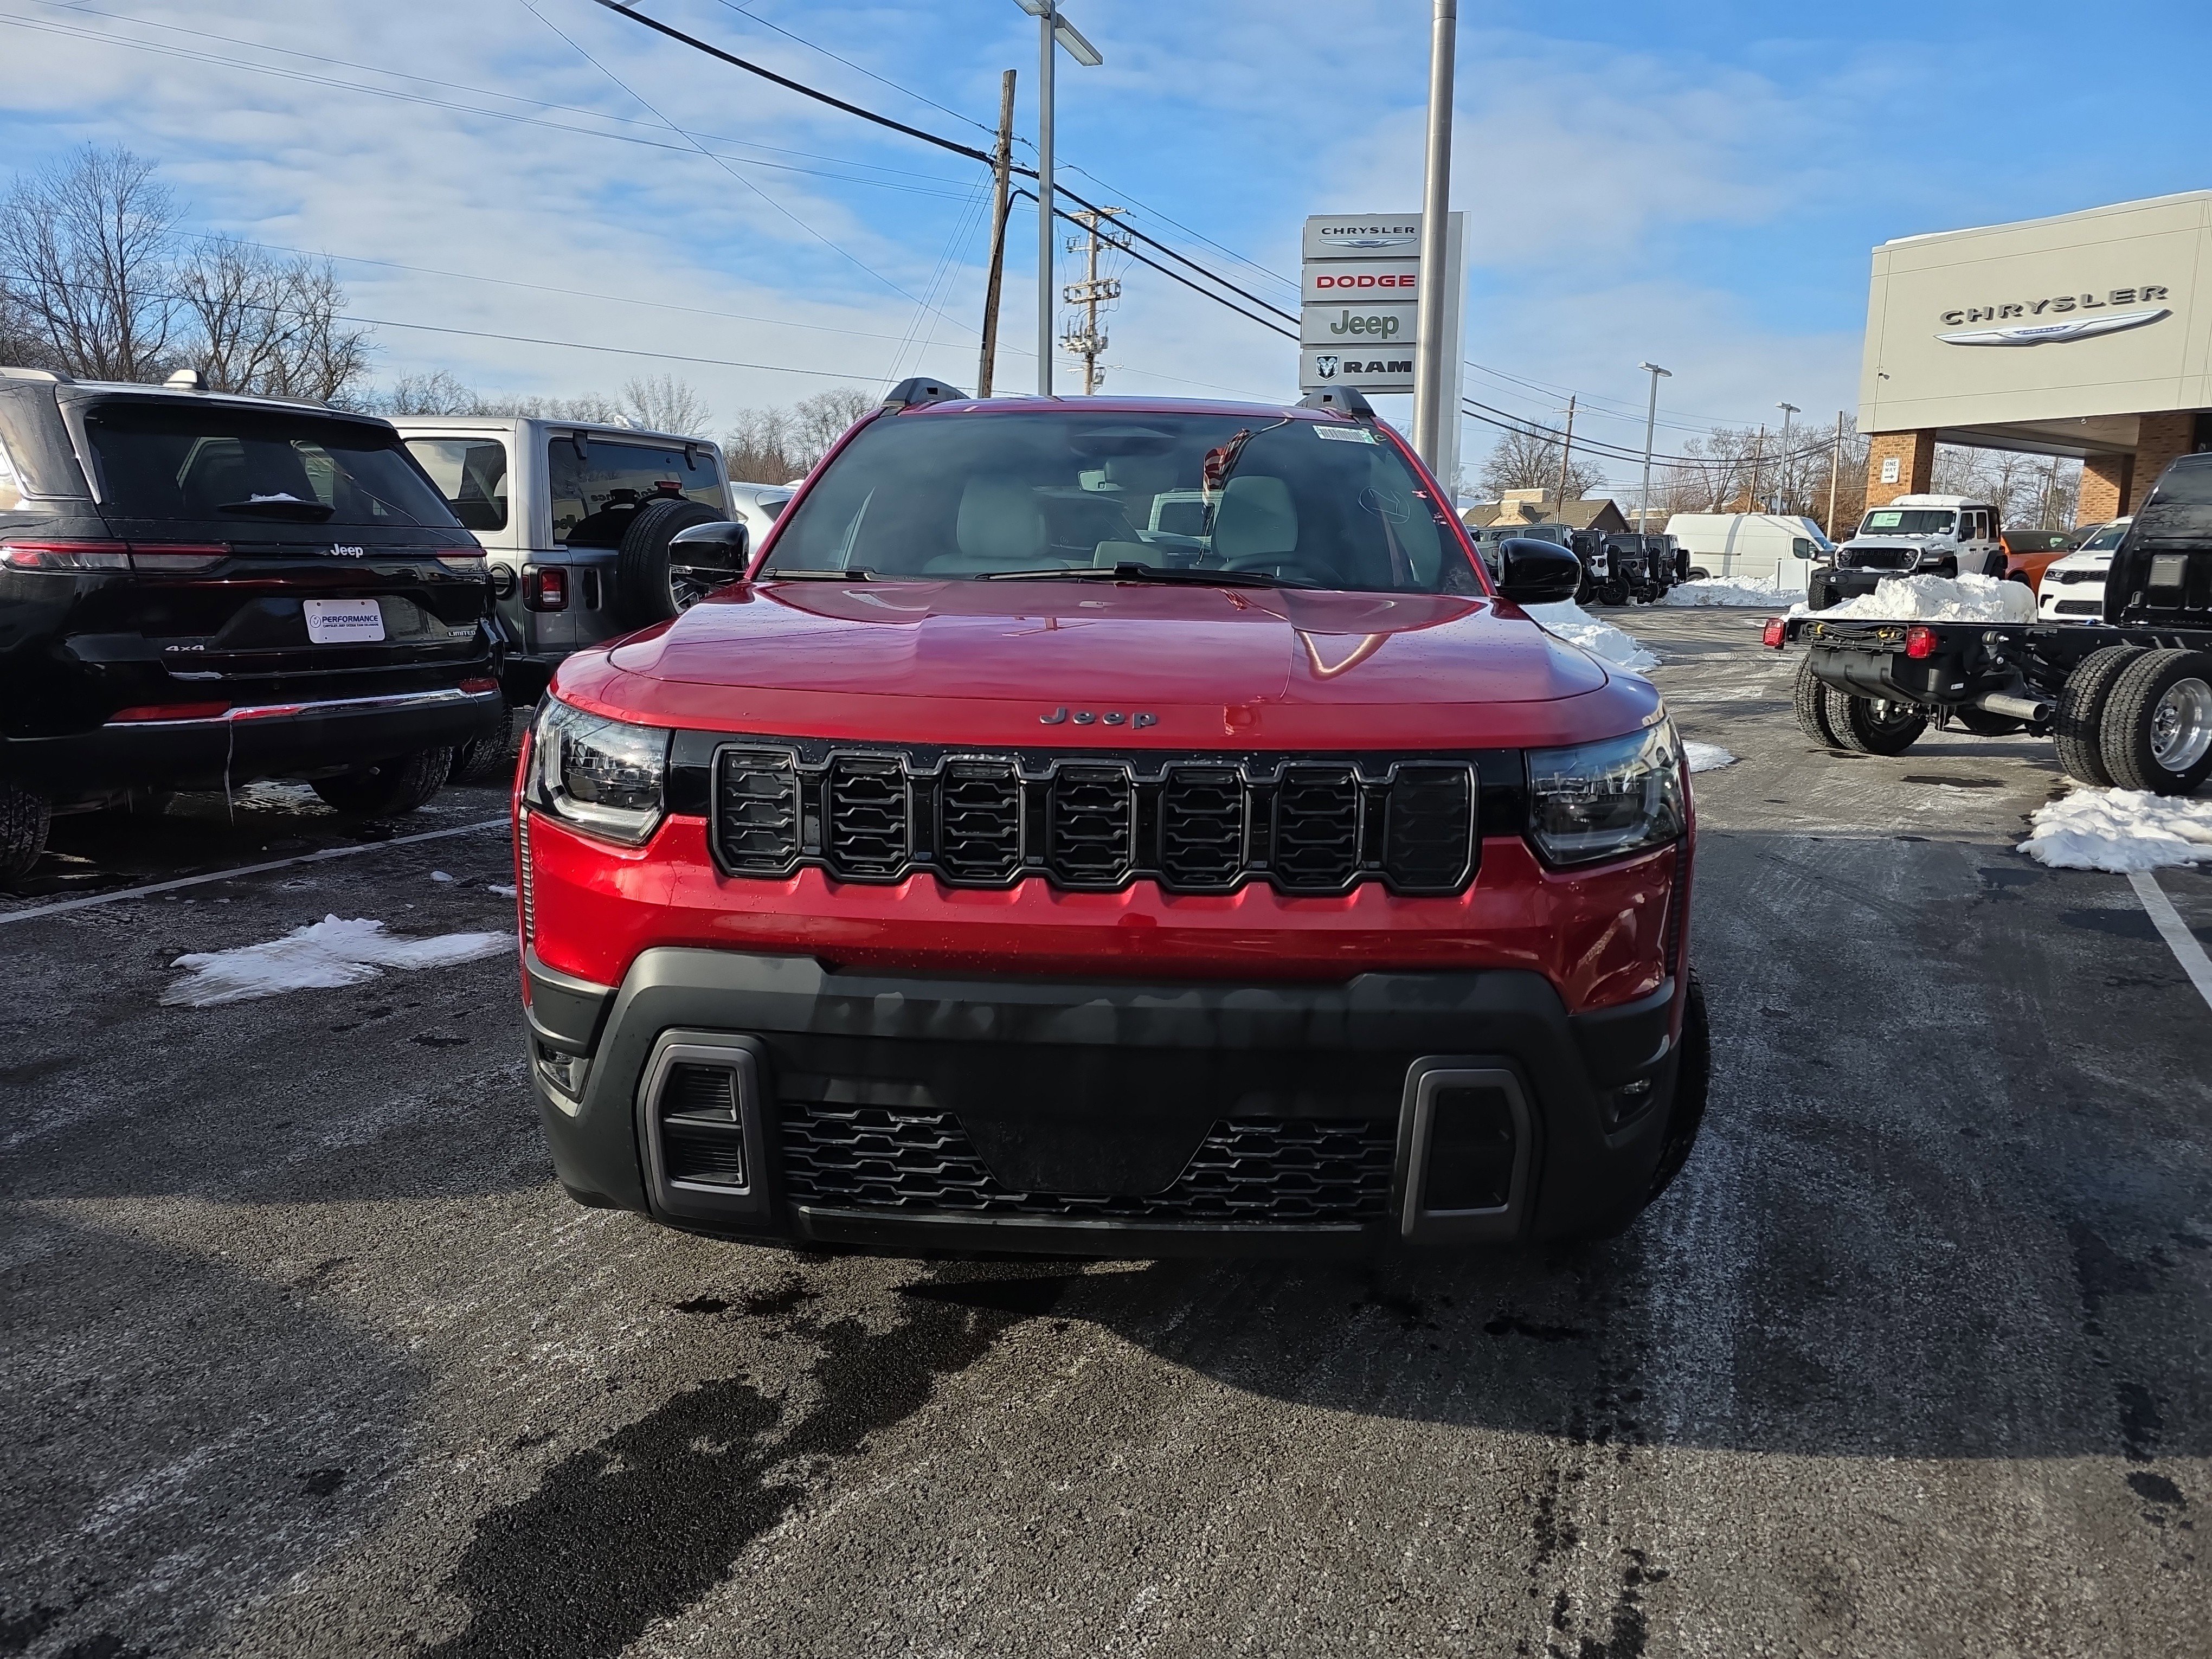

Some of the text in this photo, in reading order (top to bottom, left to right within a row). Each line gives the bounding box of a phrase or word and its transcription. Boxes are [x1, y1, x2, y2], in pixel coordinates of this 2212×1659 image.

[1321, 227, 1415, 235] CHRYSLER
[1316, 275, 1416, 288] DODGE
[1939, 285, 2169, 325] CHRYSLER
[1330, 310, 1399, 339] Jeep
[1343, 361, 1412, 373] RAM
[330, 543, 364, 558] Jeep
[1039, 707, 1157, 730] Jeep
